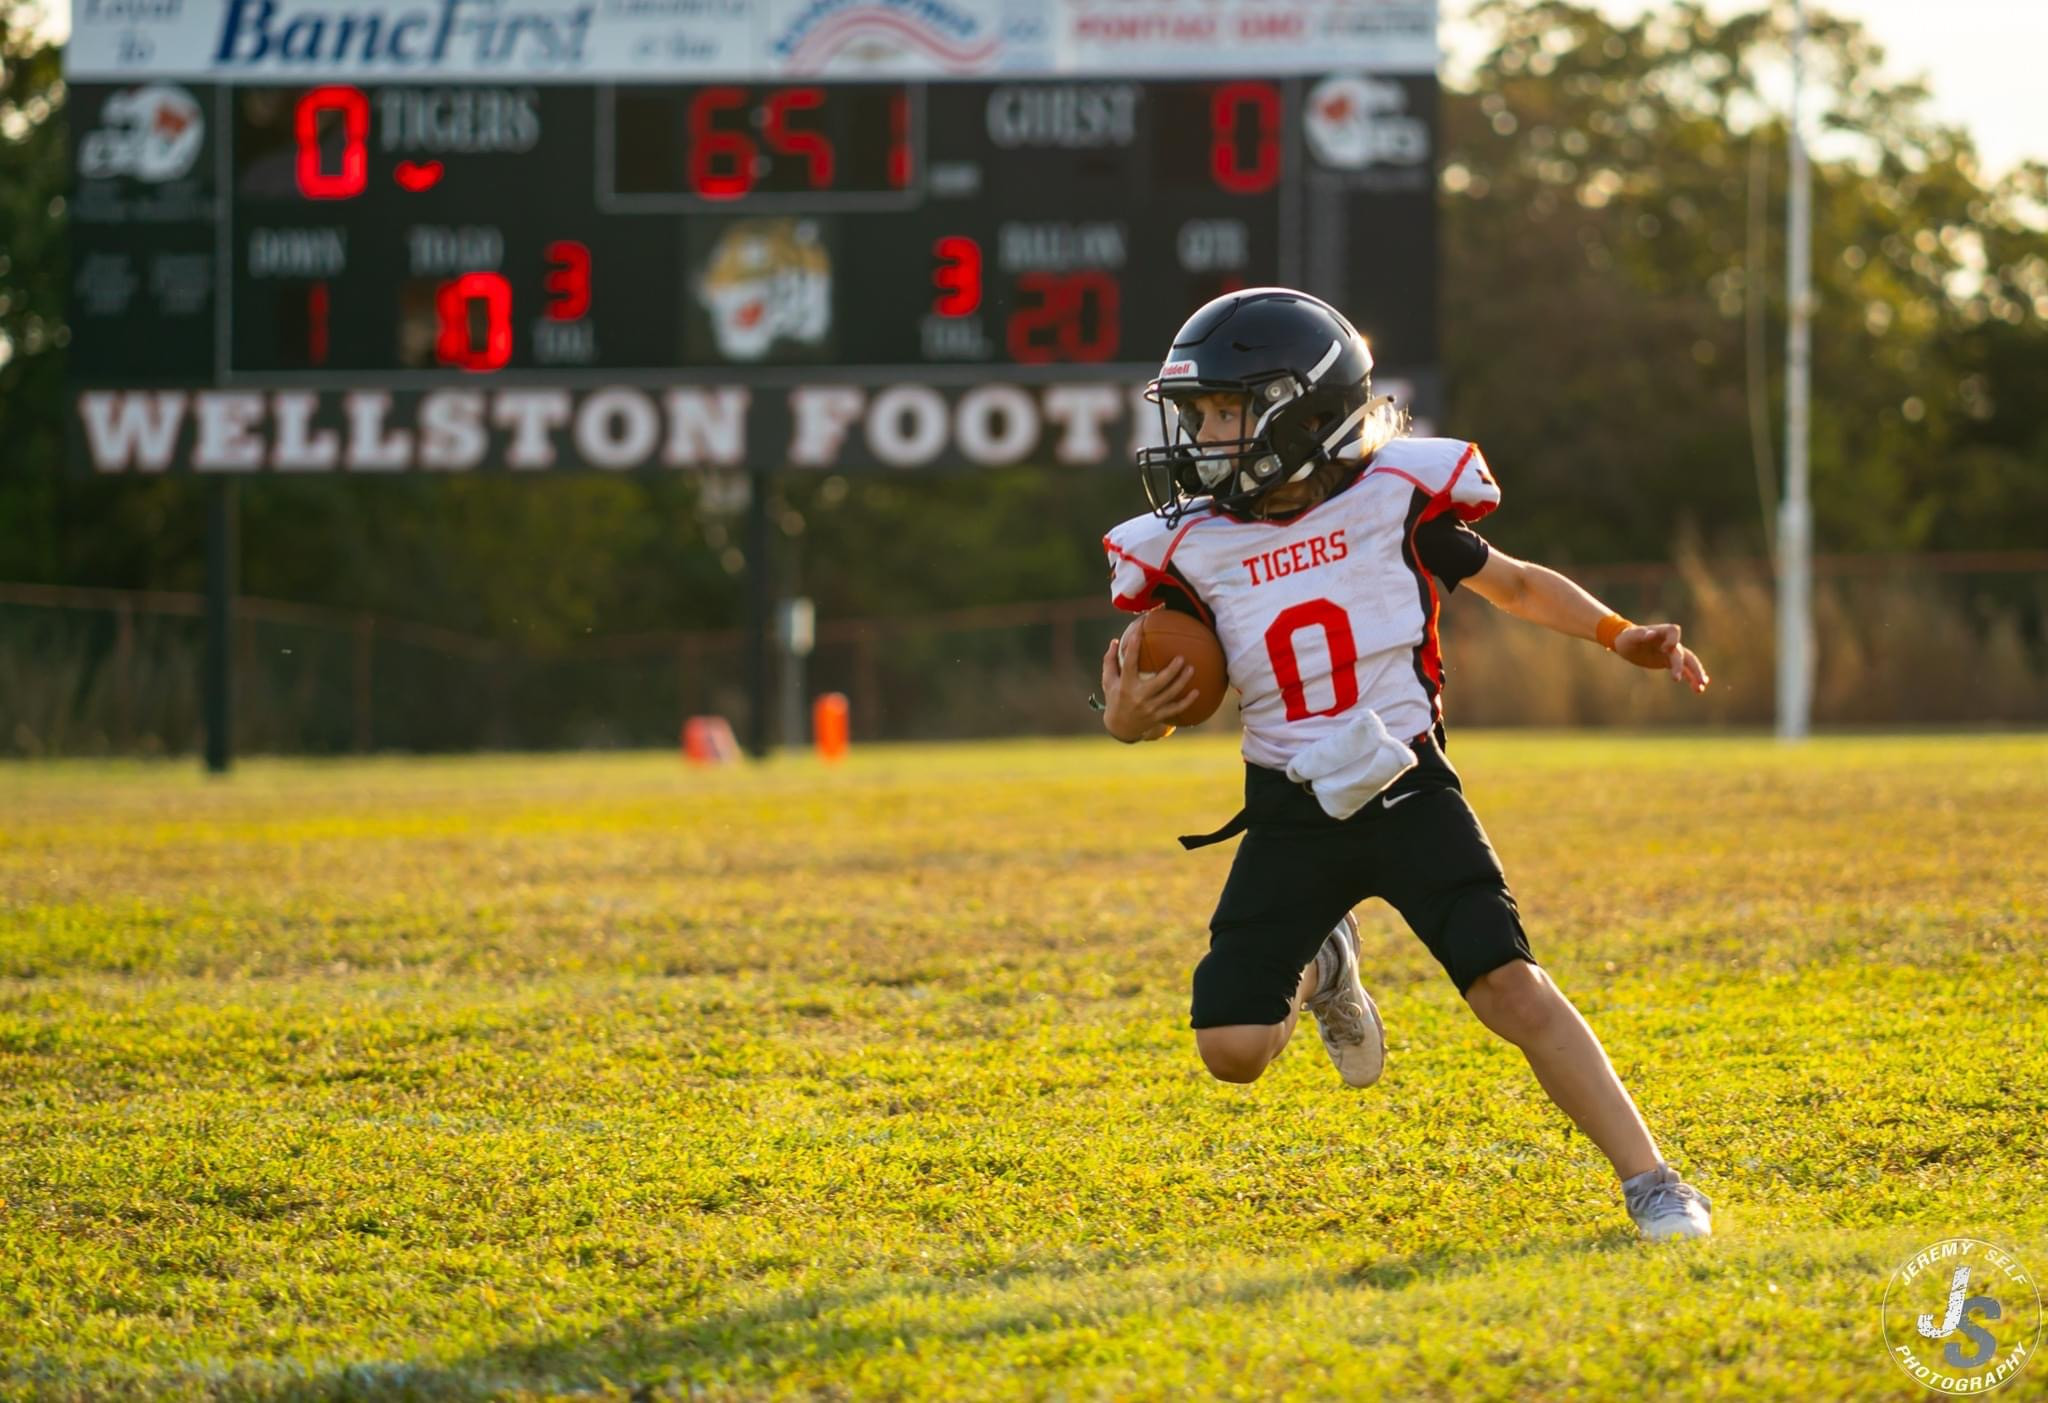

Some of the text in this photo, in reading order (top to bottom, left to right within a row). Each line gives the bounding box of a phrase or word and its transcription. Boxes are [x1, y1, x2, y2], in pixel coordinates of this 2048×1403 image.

[214, 0, 594, 63] BancFirst
[296, 84, 370, 200] 0
[380, 86, 539, 152] TIGERS
[986, 84, 1138, 147] GUEST
[1211, 81, 1283, 194] 0
[248, 226, 346, 276] DOWN
[544, 240, 592, 321] 3
[932, 234, 982, 318] 3
[1006, 270, 1121, 366] 20
[80, 387, 750, 471] WELLSTON
[1242, 529, 1348, 587] TIGERS
[1264, 598, 1358, 722] 0
